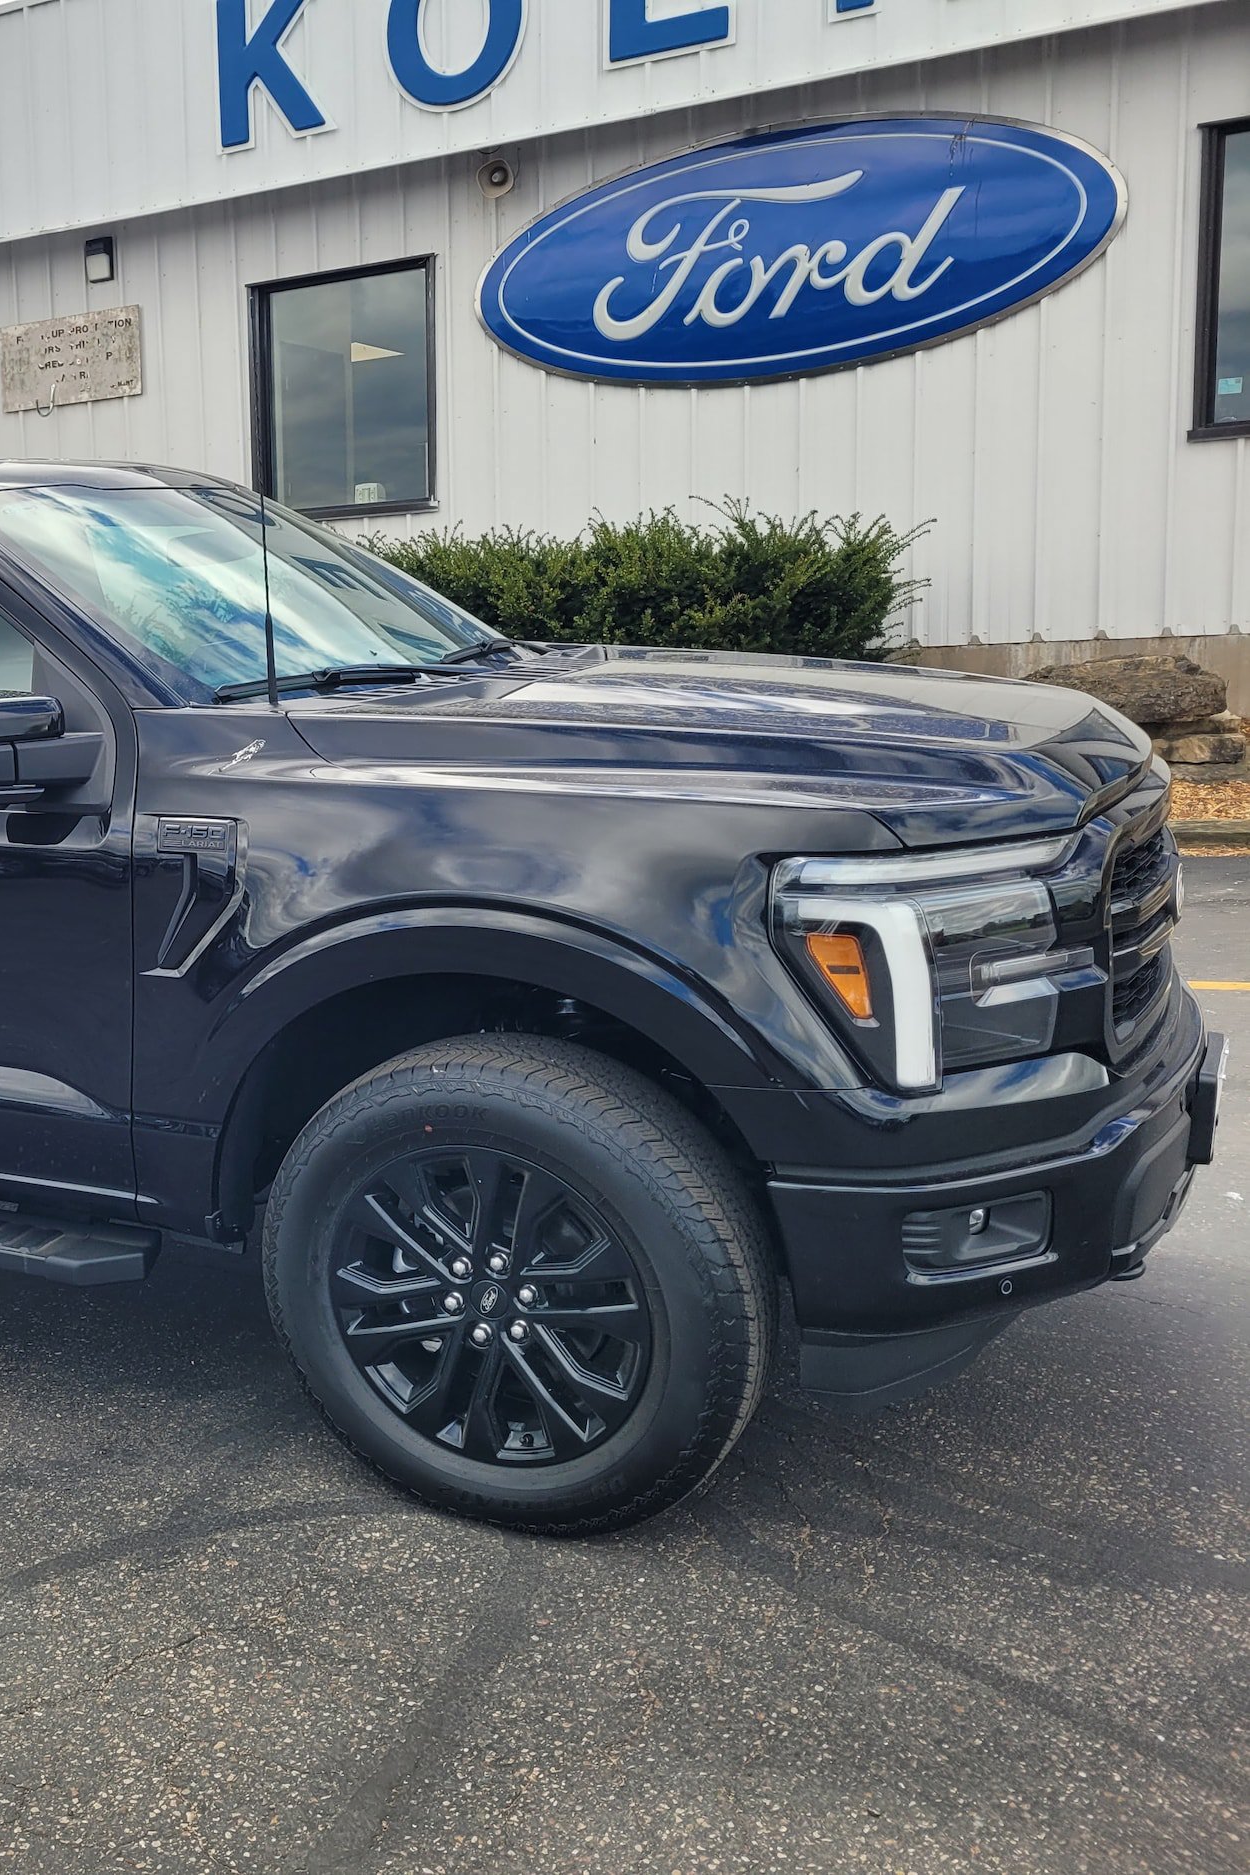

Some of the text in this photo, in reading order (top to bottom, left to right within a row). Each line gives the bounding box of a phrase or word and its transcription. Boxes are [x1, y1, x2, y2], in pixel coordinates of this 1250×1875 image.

[592, 169, 965, 342] Ford
[163, 823, 226, 839] F-150
[181, 841, 222, 849] LARIAT
